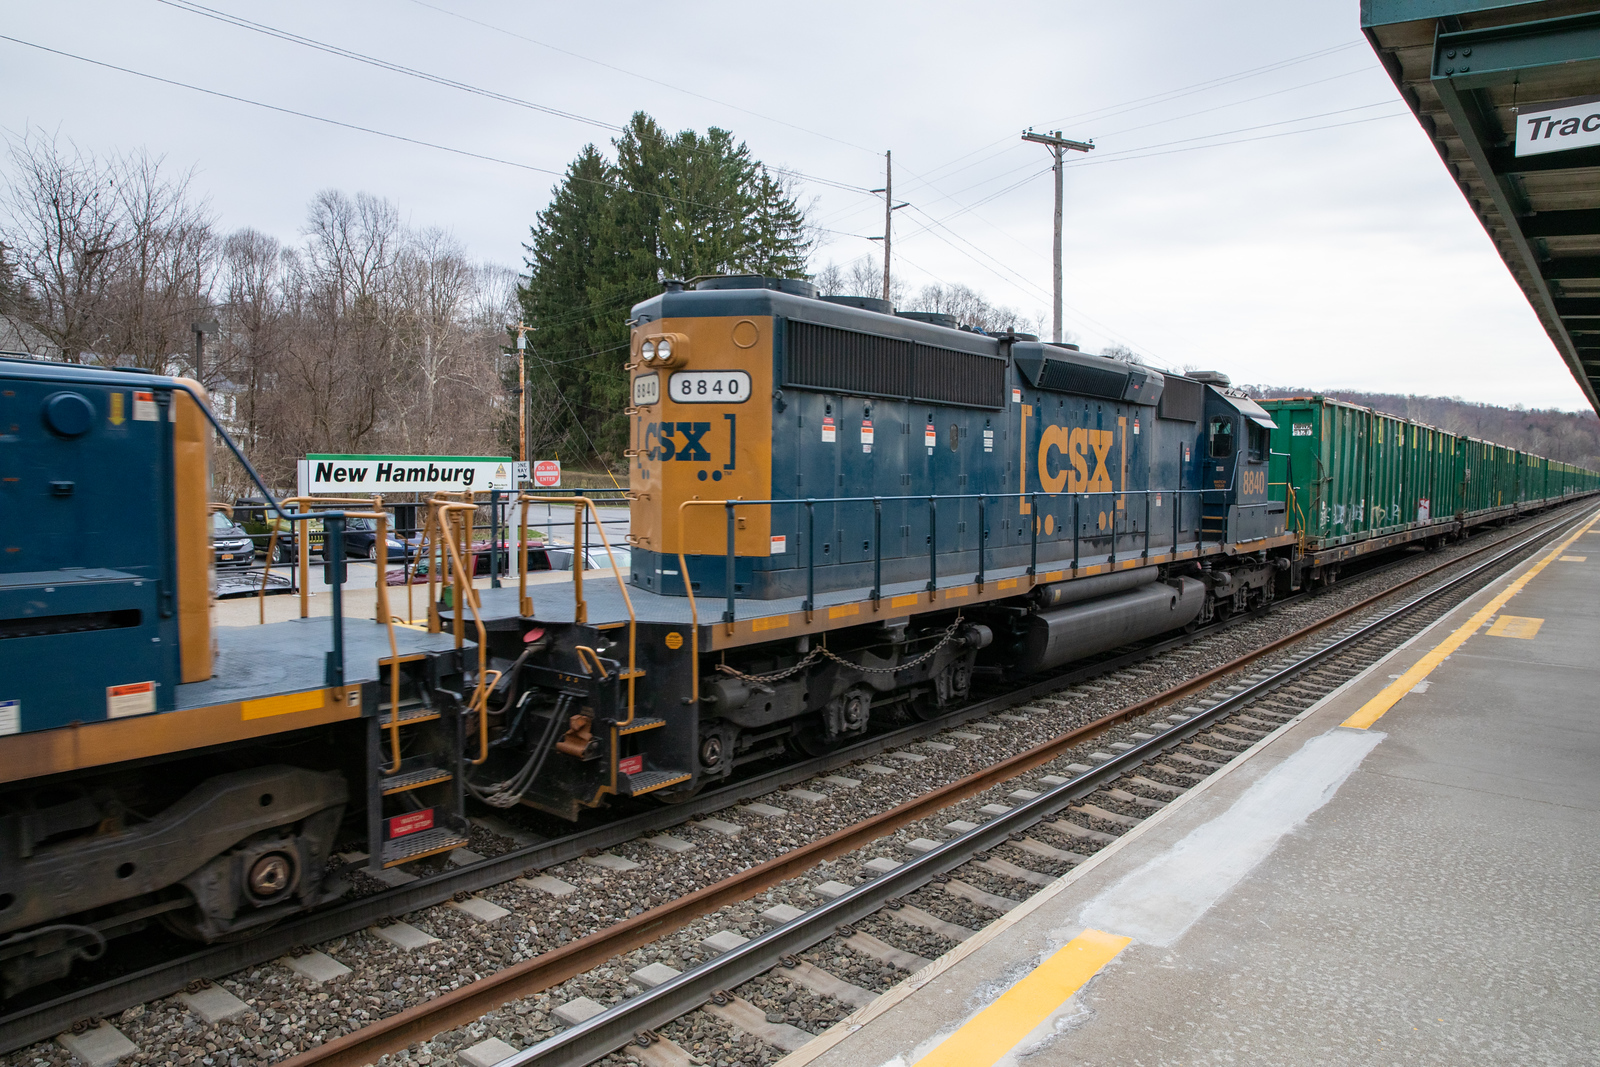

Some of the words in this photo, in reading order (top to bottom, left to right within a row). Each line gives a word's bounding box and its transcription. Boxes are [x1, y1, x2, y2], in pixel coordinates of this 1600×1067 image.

[1527, 113, 1600, 141] Trac
[637, 381, 656, 398] 8840
[681, 379, 739, 395] 8840
[315, 462, 368, 482] New
[375, 462, 475, 486] Hamburg
[1243, 470, 1265, 495] 8840
